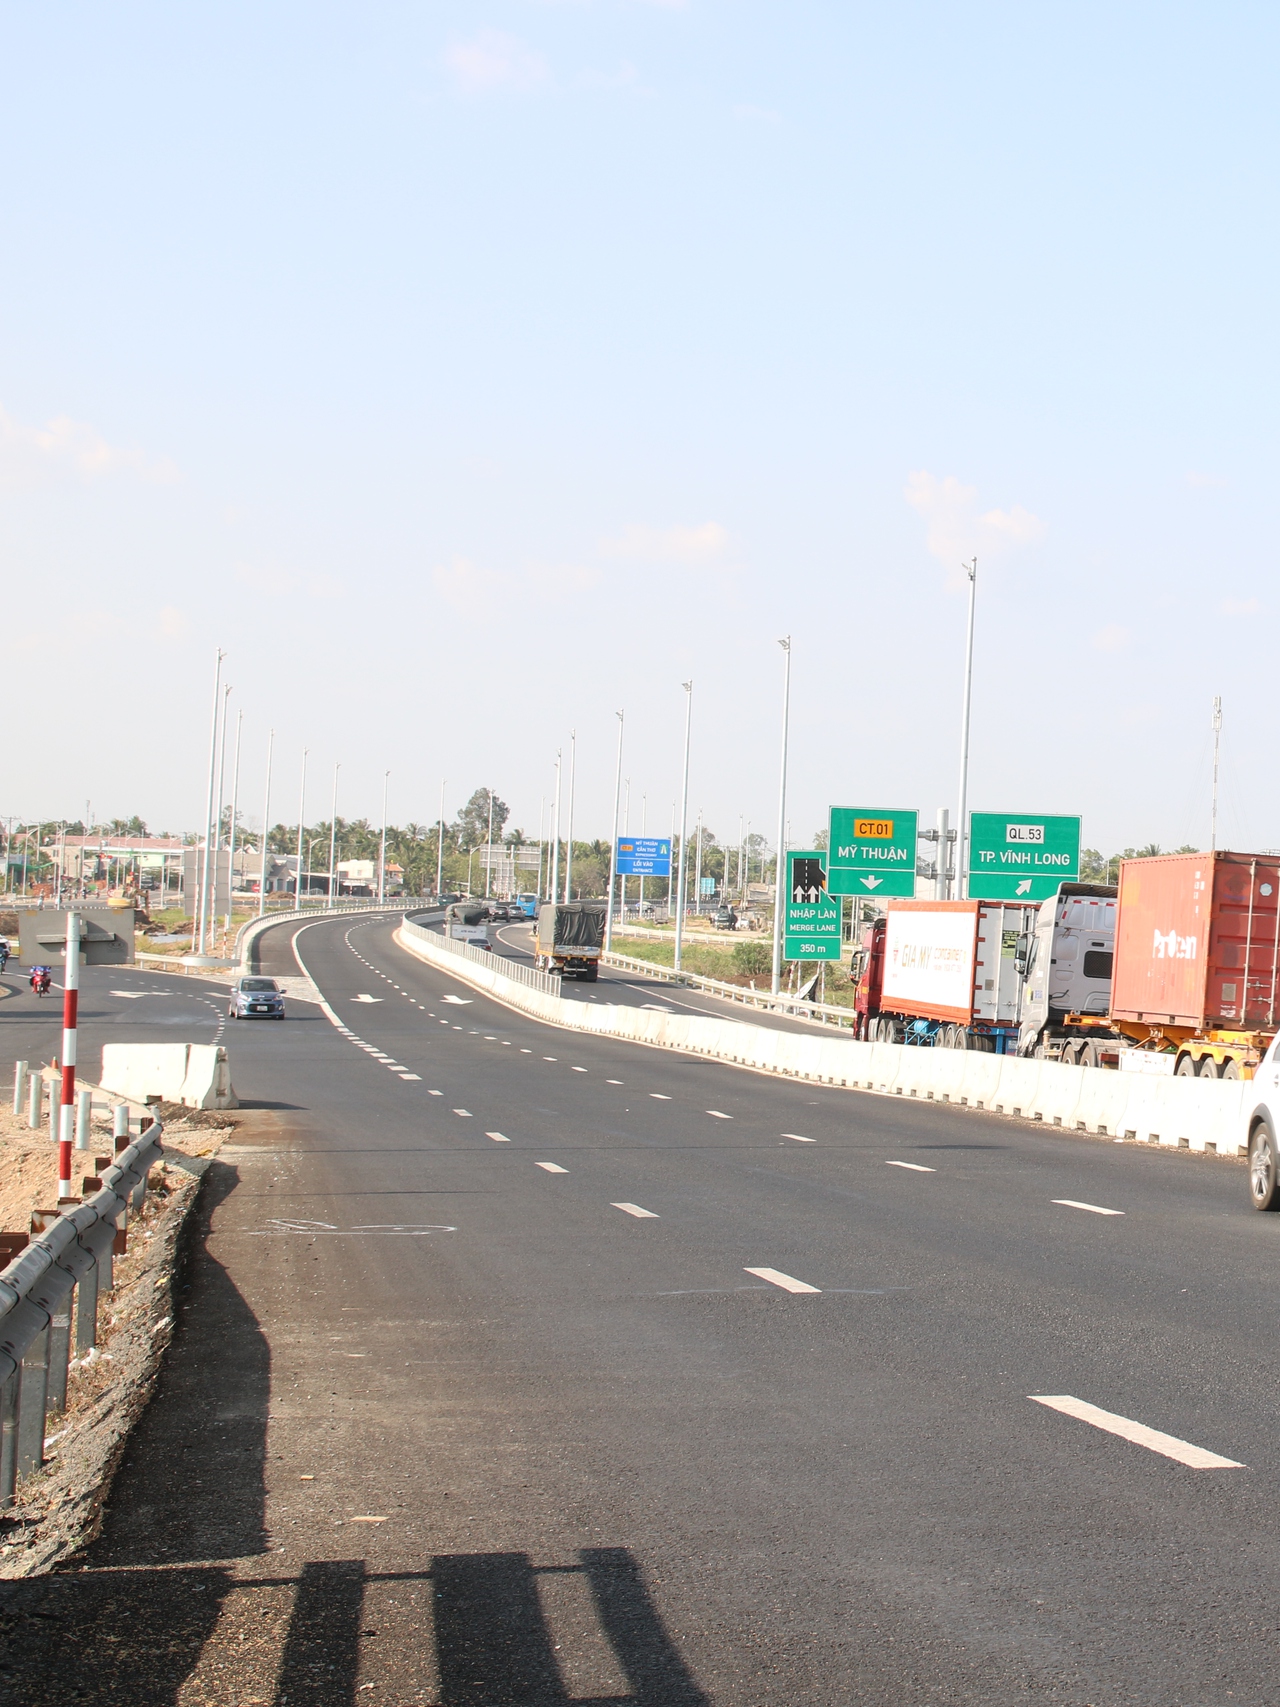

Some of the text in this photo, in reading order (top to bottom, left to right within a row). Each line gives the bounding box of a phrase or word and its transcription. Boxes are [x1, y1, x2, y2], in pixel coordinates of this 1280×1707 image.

[859, 822, 889, 836] CT.01
[1008, 827, 1042, 841] QL.53
[838, 844, 907, 862] MỸ THUẬN
[978, 849, 1071, 866] TP. VĨNH LONG
[790, 907, 837, 920] NHẬP LÀN
[789, 924, 837, 932] MERGE LANE
[800, 943, 816, 953] 350
